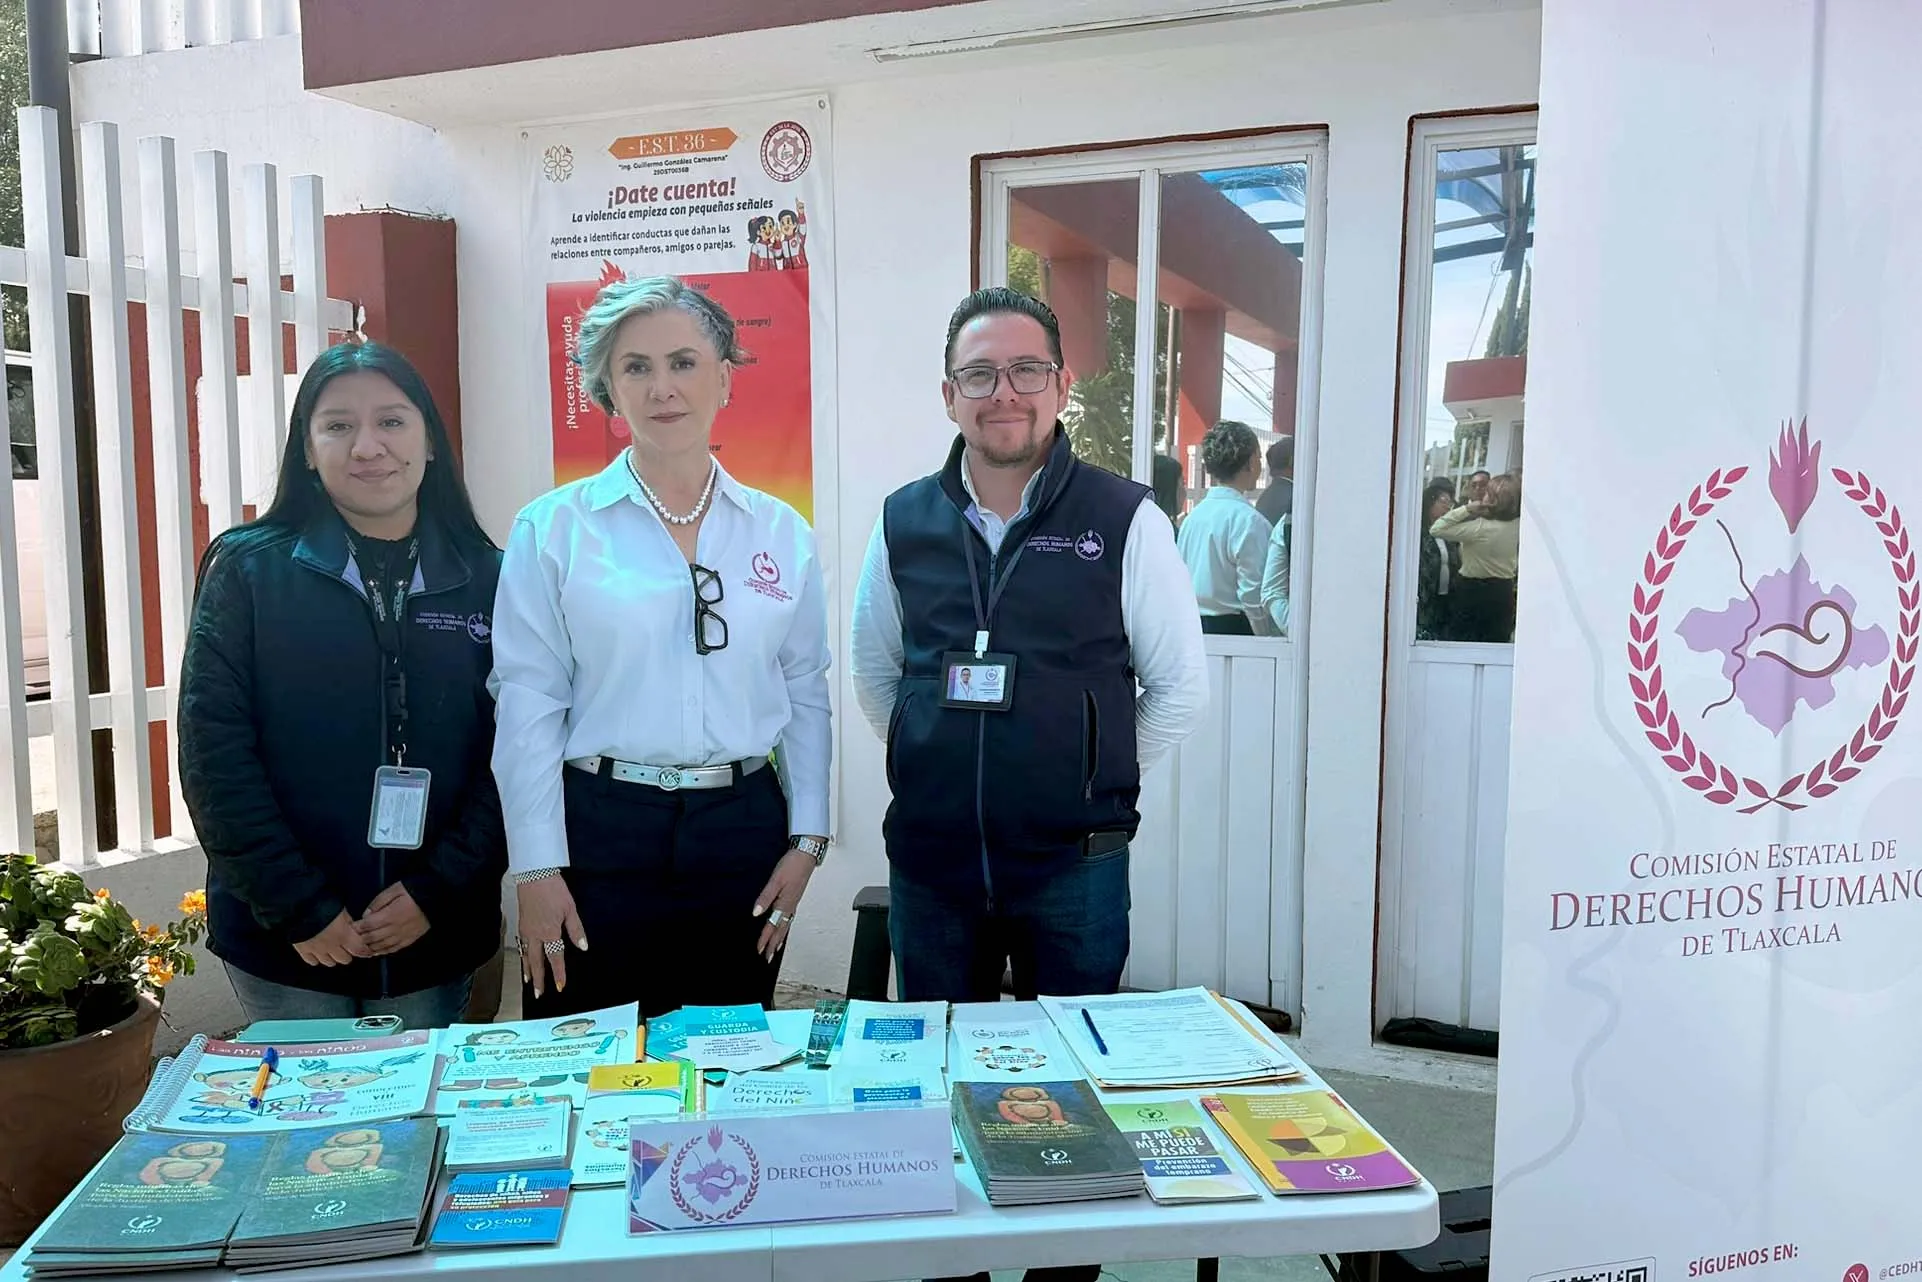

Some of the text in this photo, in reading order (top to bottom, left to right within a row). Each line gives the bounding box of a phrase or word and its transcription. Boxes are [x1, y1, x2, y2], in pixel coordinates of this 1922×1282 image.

[639, 133, 705, 155] E.S.T. 36
[633, 161, 663, 169] Guillermo
[607, 177, 737, 209] ¡Date cuenta!
[572, 198, 773, 223] La violencia empieza con pequeñas señales
[550, 224, 731, 246] Aprende a identificar conductas que dañan las
[550, 249, 589, 260] relaciones
[590, 247, 612, 258] entre
[613, 244, 664, 259] compañeros,
[665, 242, 694, 255] amigos
[703, 239, 736, 253] parejas.
[561, 315, 579, 430] ¡Necesitas ayuda
[1629, 839, 1898, 880] COMISIÓN ESTATAL DE
[1549, 869, 1922, 932] DERECHOS HUMAN
[1681, 922, 1842, 957] DE TLAXCALA
[709, 1026, 759, 1035] CUSTODIA
[1135, 1136, 1206, 1149] ME PUEDE
[1140, 1132, 1151, 1140] A
[800, 1152, 850, 1163] COMISIÓN
[853, 1150, 890, 1161] ESTATAL
[1150, 1147, 1199, 1156] PASAR
[1155, 1158, 1208, 1166] Prevención
[767, 1159, 939, 1181] DERECHOS HUMANOS
[820, 1177, 883, 1190] DE TLAXCALA
[494, 1217, 532, 1225] CNDH
[1688, 1242, 1800, 1278] SÍGUENOS EN:
